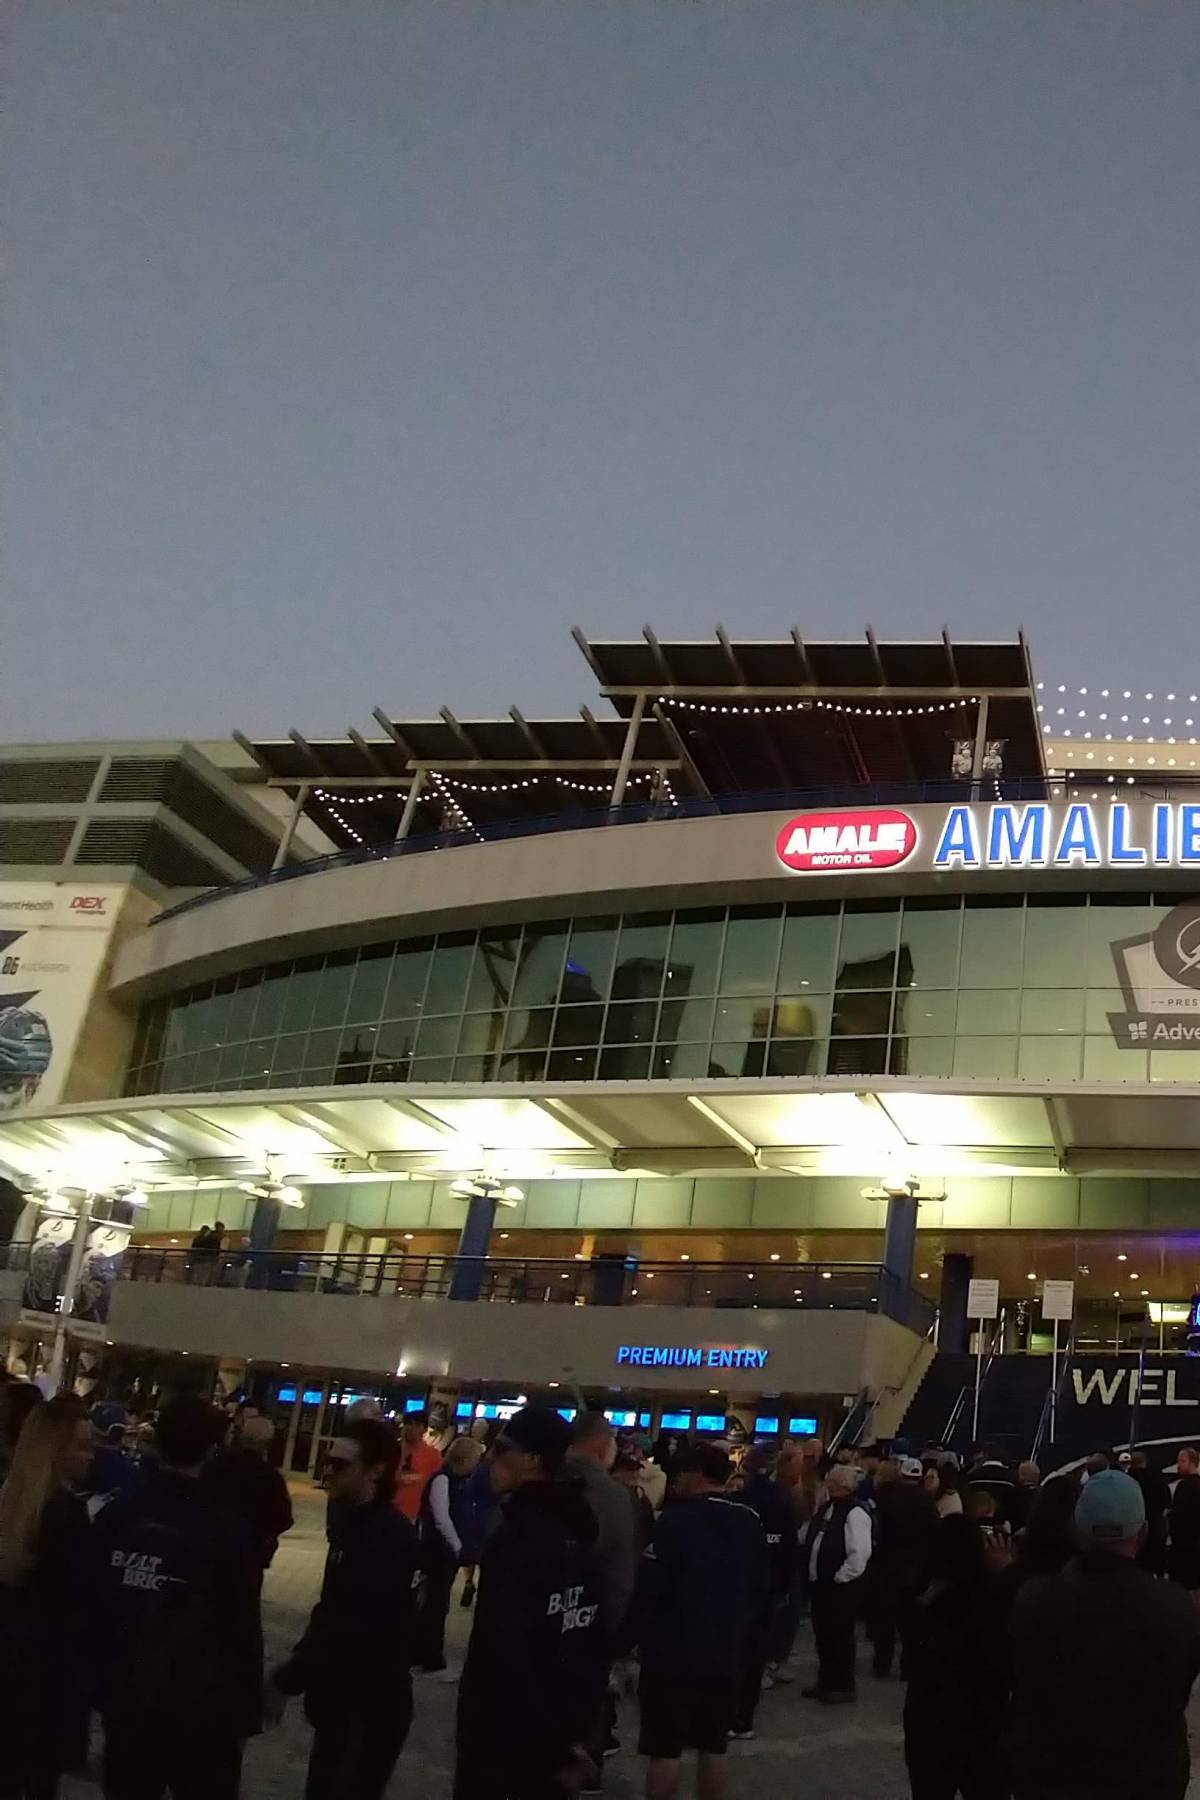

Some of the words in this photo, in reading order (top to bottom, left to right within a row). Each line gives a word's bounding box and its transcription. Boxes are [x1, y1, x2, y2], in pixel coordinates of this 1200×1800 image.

[784, 823, 907, 854] AMALIE
[811, 854, 852, 865] MOTOR
[854, 853, 873, 864] OIL
[69, 896, 108, 909] DEX
[617, 1346, 703, 1367] PREMIUM
[707, 1349, 769, 1368] ENTRY
